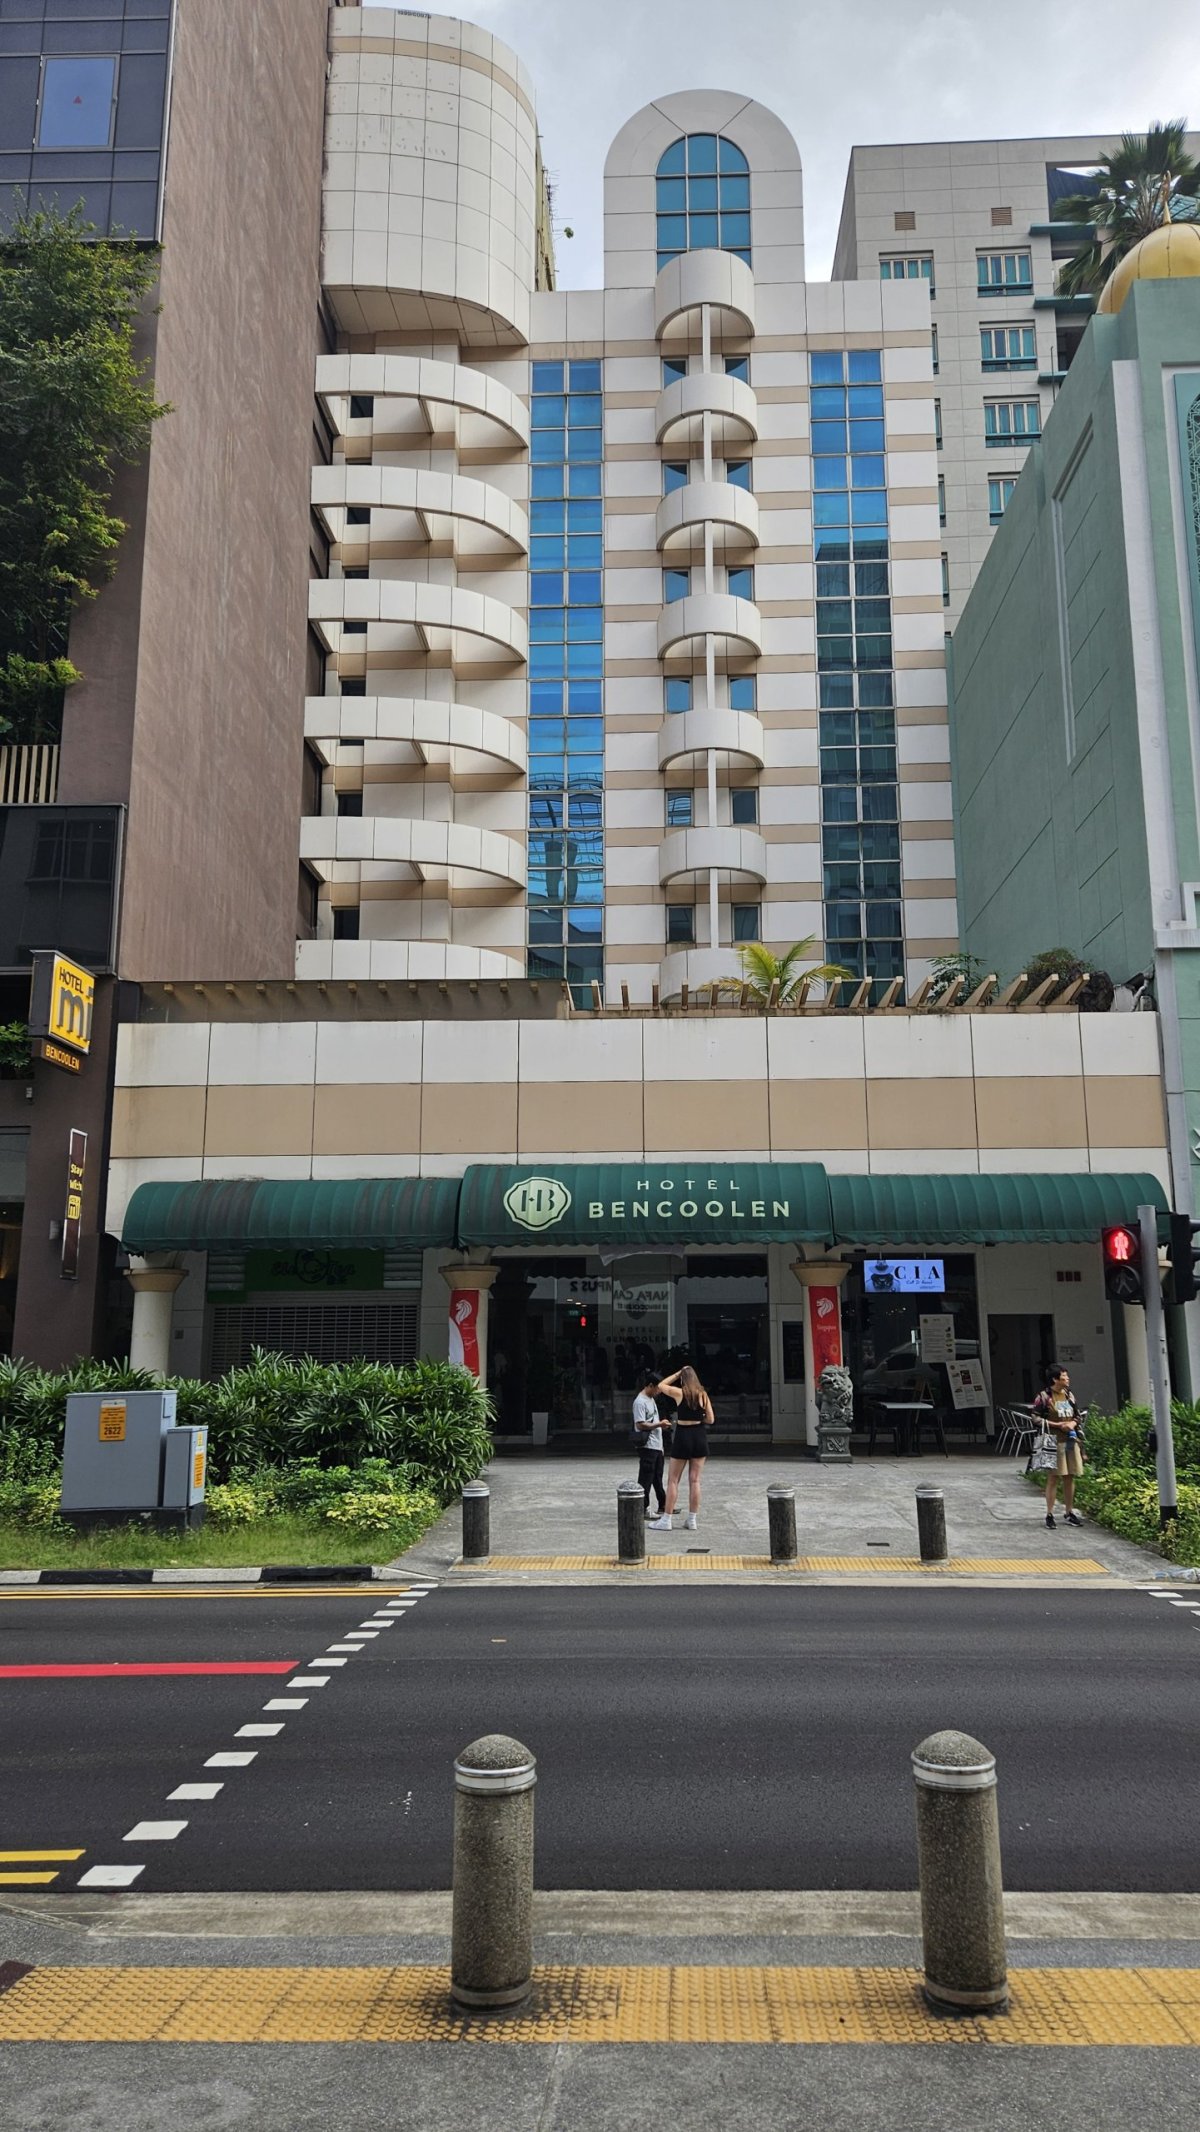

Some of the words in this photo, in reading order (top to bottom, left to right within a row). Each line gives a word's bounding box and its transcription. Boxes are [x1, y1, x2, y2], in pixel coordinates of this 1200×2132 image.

[59, 967, 84, 994] HOTEL
[57, 986, 94, 1042] mi
[45, 1044, 80, 1071] BENCOOLEN
[70, 1163, 83, 1178] Stay
[637, 1180, 740, 1191] HOTEL
[588, 1200, 790, 1219] BENCOOLEN
